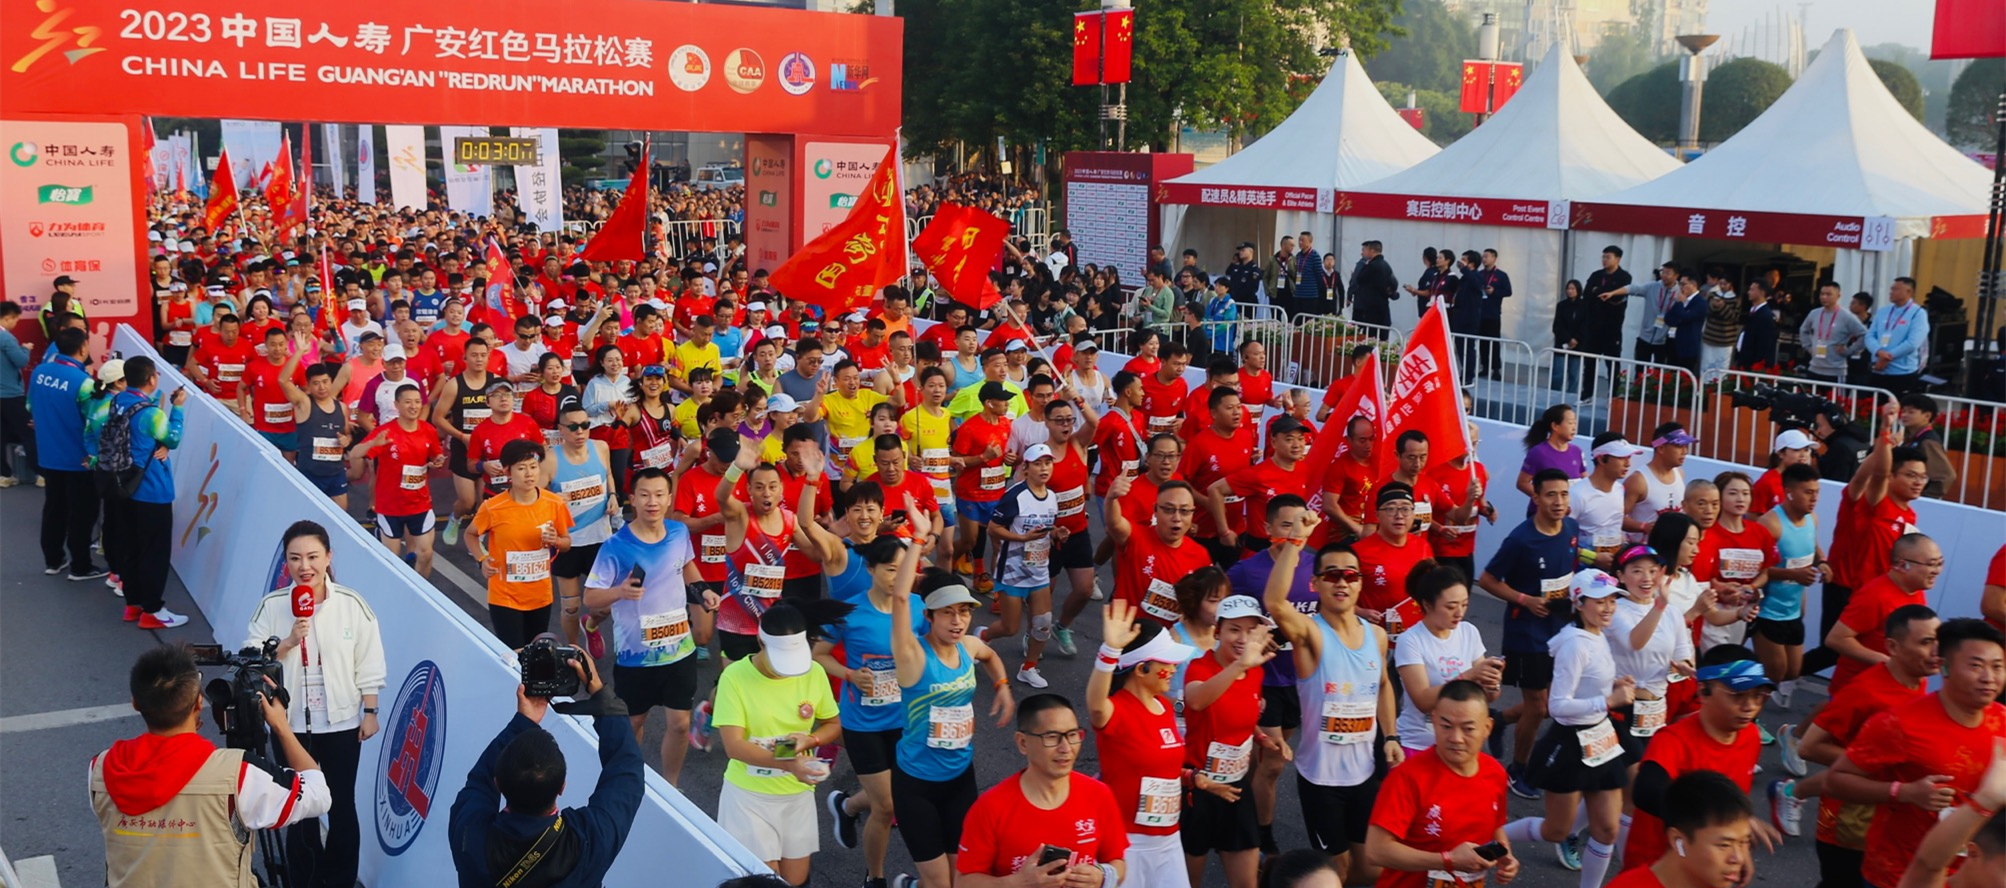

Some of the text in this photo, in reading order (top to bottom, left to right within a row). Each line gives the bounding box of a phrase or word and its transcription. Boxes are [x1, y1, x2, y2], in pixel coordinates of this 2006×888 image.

[119, 9, 654, 69] 2023 中国人寿 广安红色马拉松赛
[121, 55, 229, 79] CHINA
[240, 61, 307, 82] LIFE
[317, 65, 435, 89] GUANG'AN
[740, 66, 762, 76] CAA
[45, 144, 115, 157] 中国人寿
[46, 158, 115, 167] CHINA LIFE
[1201, 188, 1277, 206] 配速员&精英选手
[1406, 199, 1483, 220] 赛后控制中心
[1513, 204, 1546, 213] Post Event
[1502, 213, 1545, 222] Control Centre
[1834, 221, 1861, 231] Audio
[1826, 232, 1859, 243] Control
[36, 373, 69, 391] SCAA
[570, 485, 602, 502] B52208
[516, 560, 548, 574] B61621
[651, 623, 686, 640] B50811
[380, 800, 411, 840] XINHUA
[502, 868, 523, 888] Nikon
